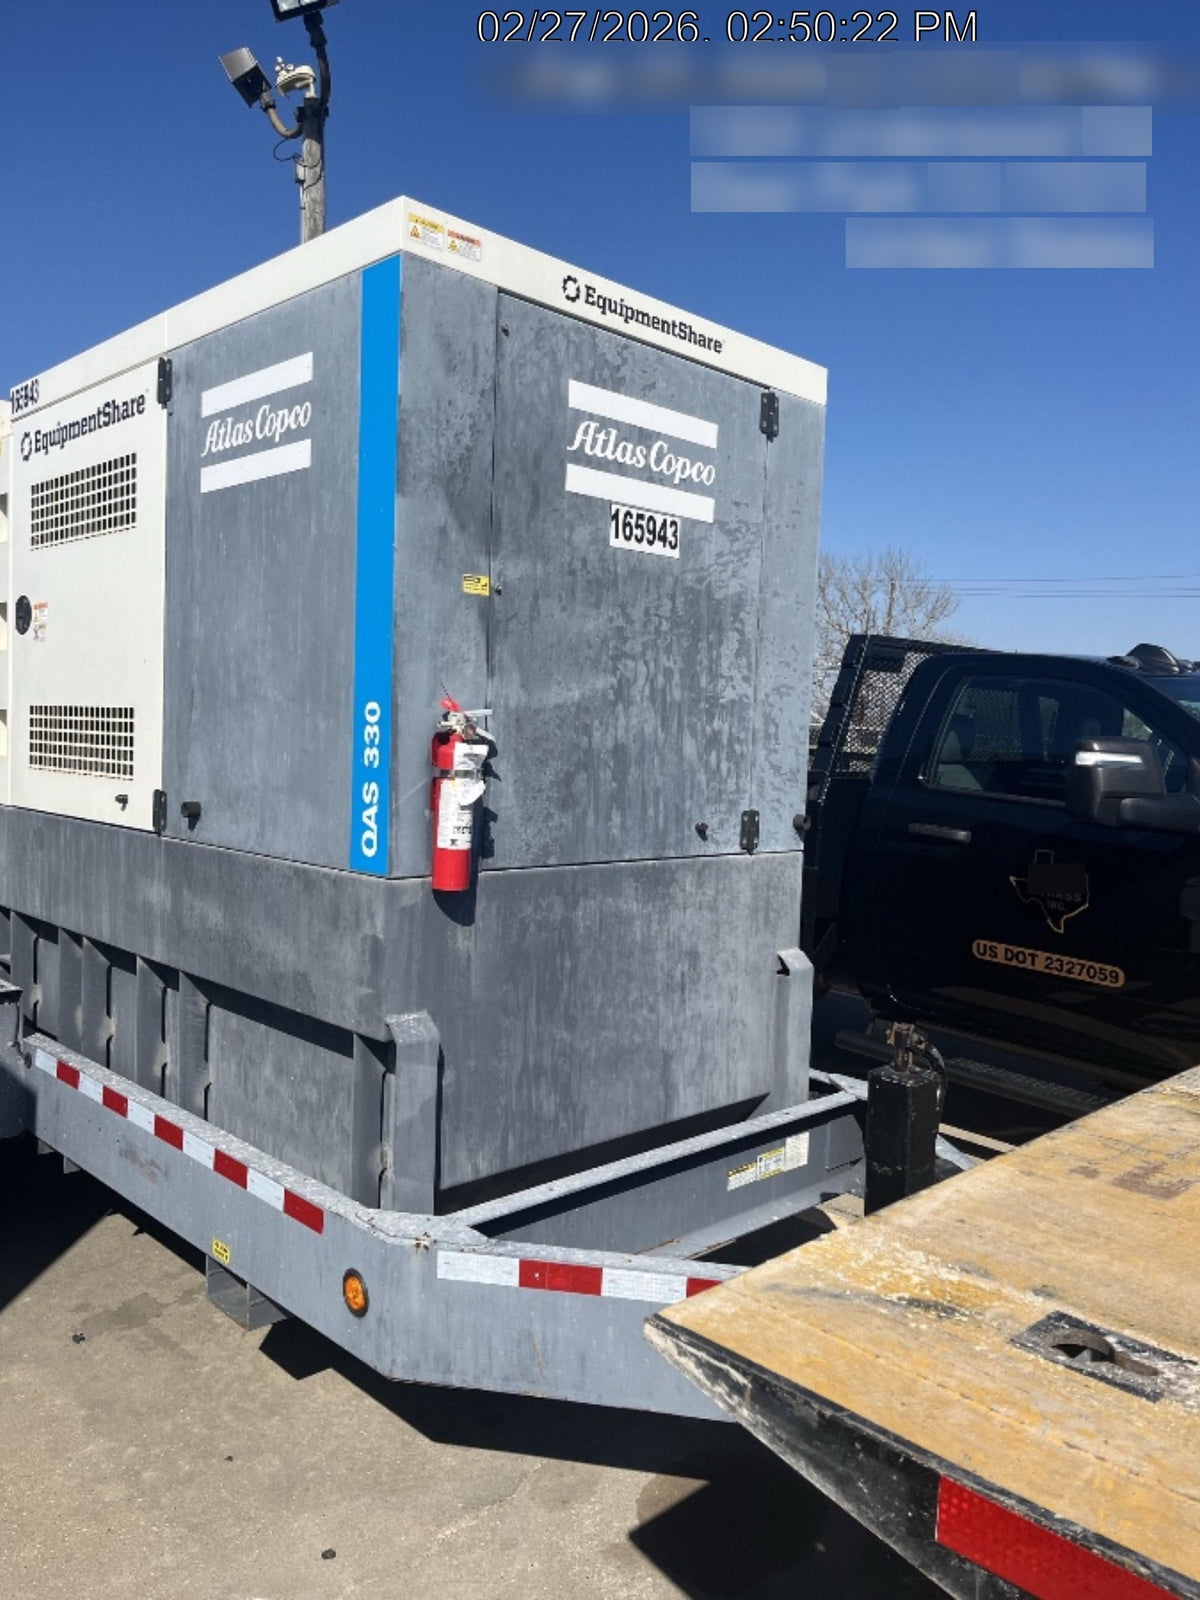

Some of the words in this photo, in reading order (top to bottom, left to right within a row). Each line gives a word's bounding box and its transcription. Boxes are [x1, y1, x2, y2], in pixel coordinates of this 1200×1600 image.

[584, 284, 723, 353] EquipmentShare
[34, 394, 145, 455] EquipmentShare
[201, 417, 253, 457] Atlas
[255, 401, 311, 443] Copco
[567, 420, 647, 468] Atlas
[650, 440, 716, 486] Copco
[611, 508, 678, 550] 165943
[363, 701, 381, 769] 330
[361, 780, 380, 858] QAS
[976, 942, 999, 958] US
[1004, 947, 1039, 966] DOT
[1045, 956, 1120, 984] 2327059
